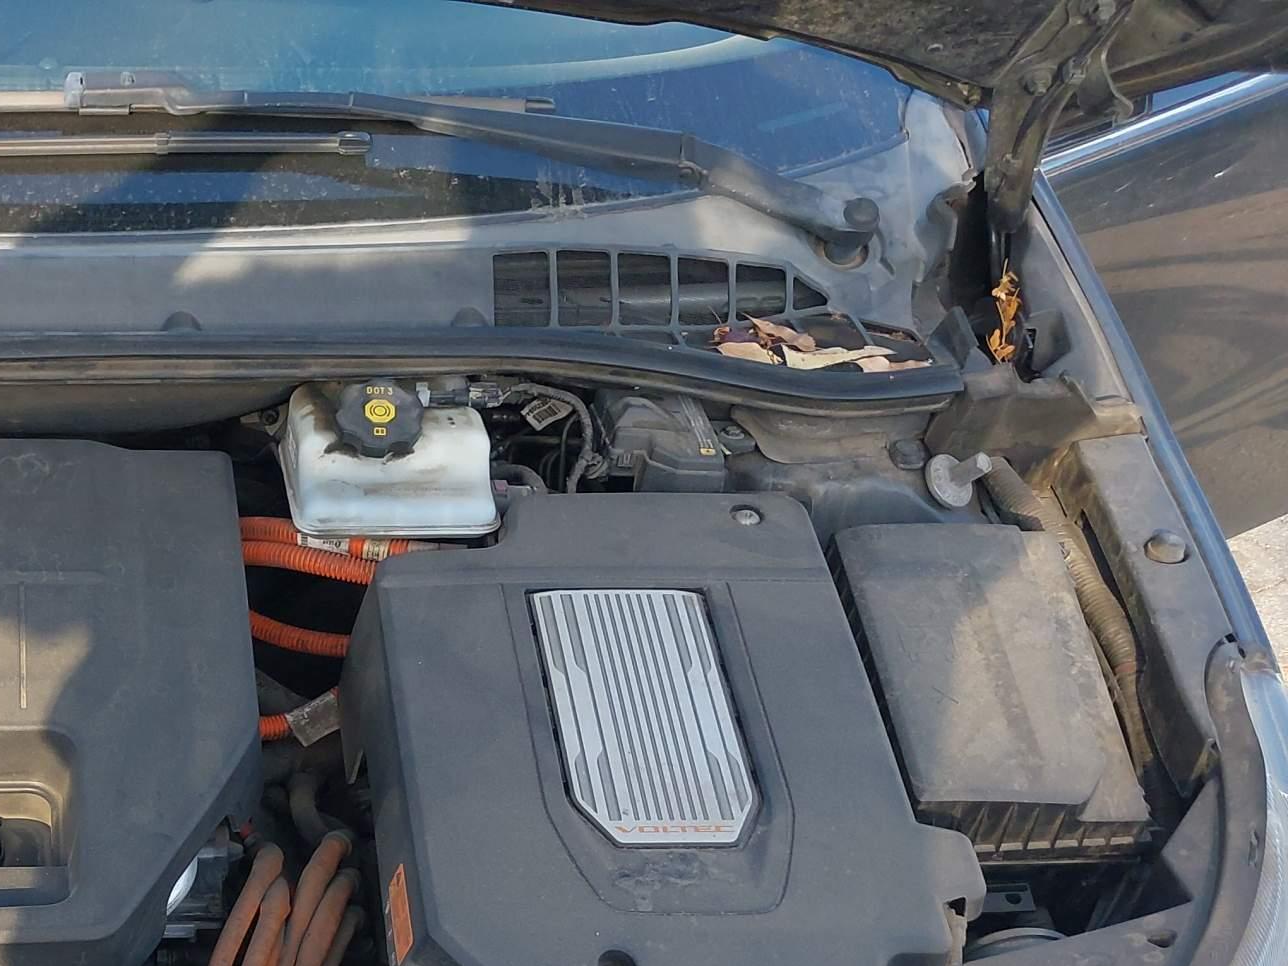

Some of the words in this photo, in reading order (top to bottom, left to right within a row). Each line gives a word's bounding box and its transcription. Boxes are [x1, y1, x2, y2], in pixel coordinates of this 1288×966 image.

[366, 386, 385, 394] DOT
[387, 386, 393, 396] 3
[614, 825, 735, 833] VOLTEC
